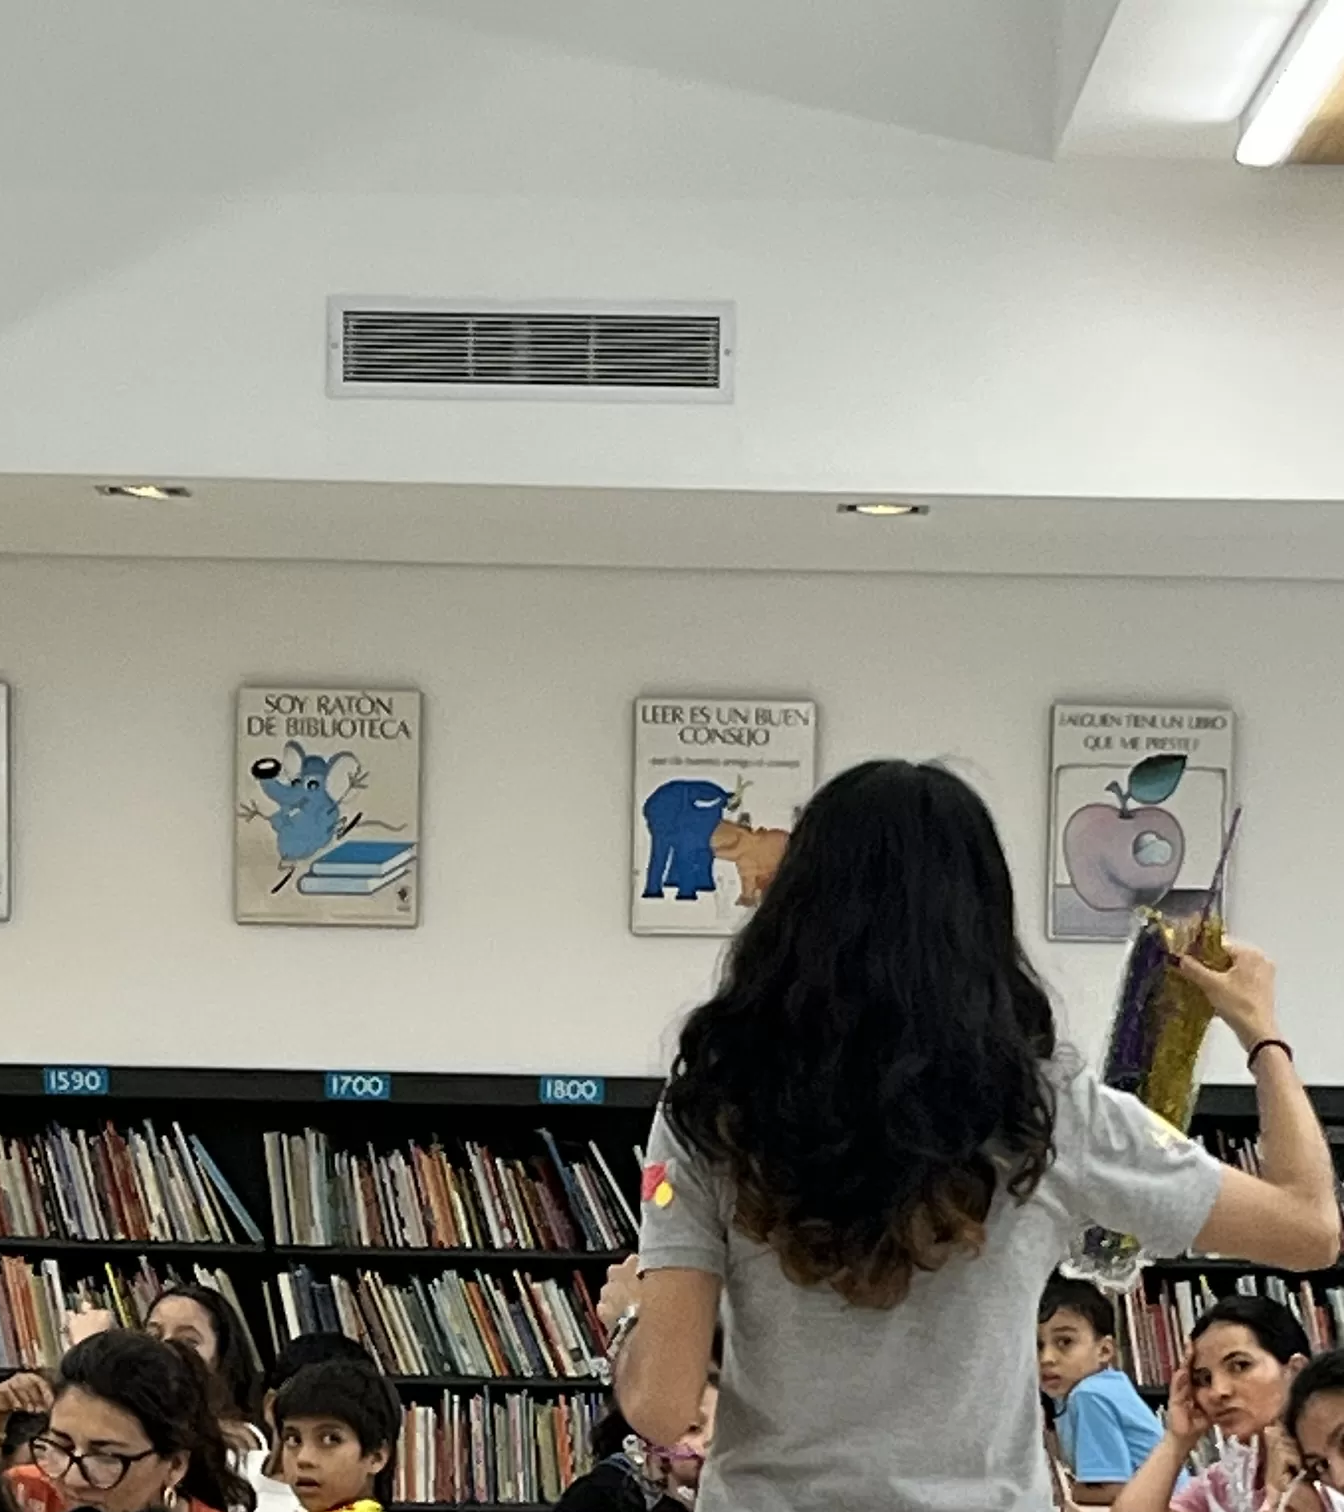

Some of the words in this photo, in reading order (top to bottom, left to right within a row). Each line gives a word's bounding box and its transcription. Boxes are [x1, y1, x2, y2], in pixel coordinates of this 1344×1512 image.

[264, 694, 308, 714] SOY
[641, 705, 684, 724] LEER
[690, 706, 711, 725] ES
[716, 707, 749, 726] UN
[755, 707, 810, 727] BUEN
[1161, 714, 1184, 730] UN
[247, 716, 277, 737] DE
[286, 717, 412, 740] BIBLIOTECA
[677, 727, 770, 748] CONSEJO
[1083, 735, 1113, 752] QUE
[1119, 737, 1140, 751] ME
[49, 1070, 101, 1091] 1590
[332, 1075, 383, 1096] 1700
[546, 1079, 597, 1100] 1800
